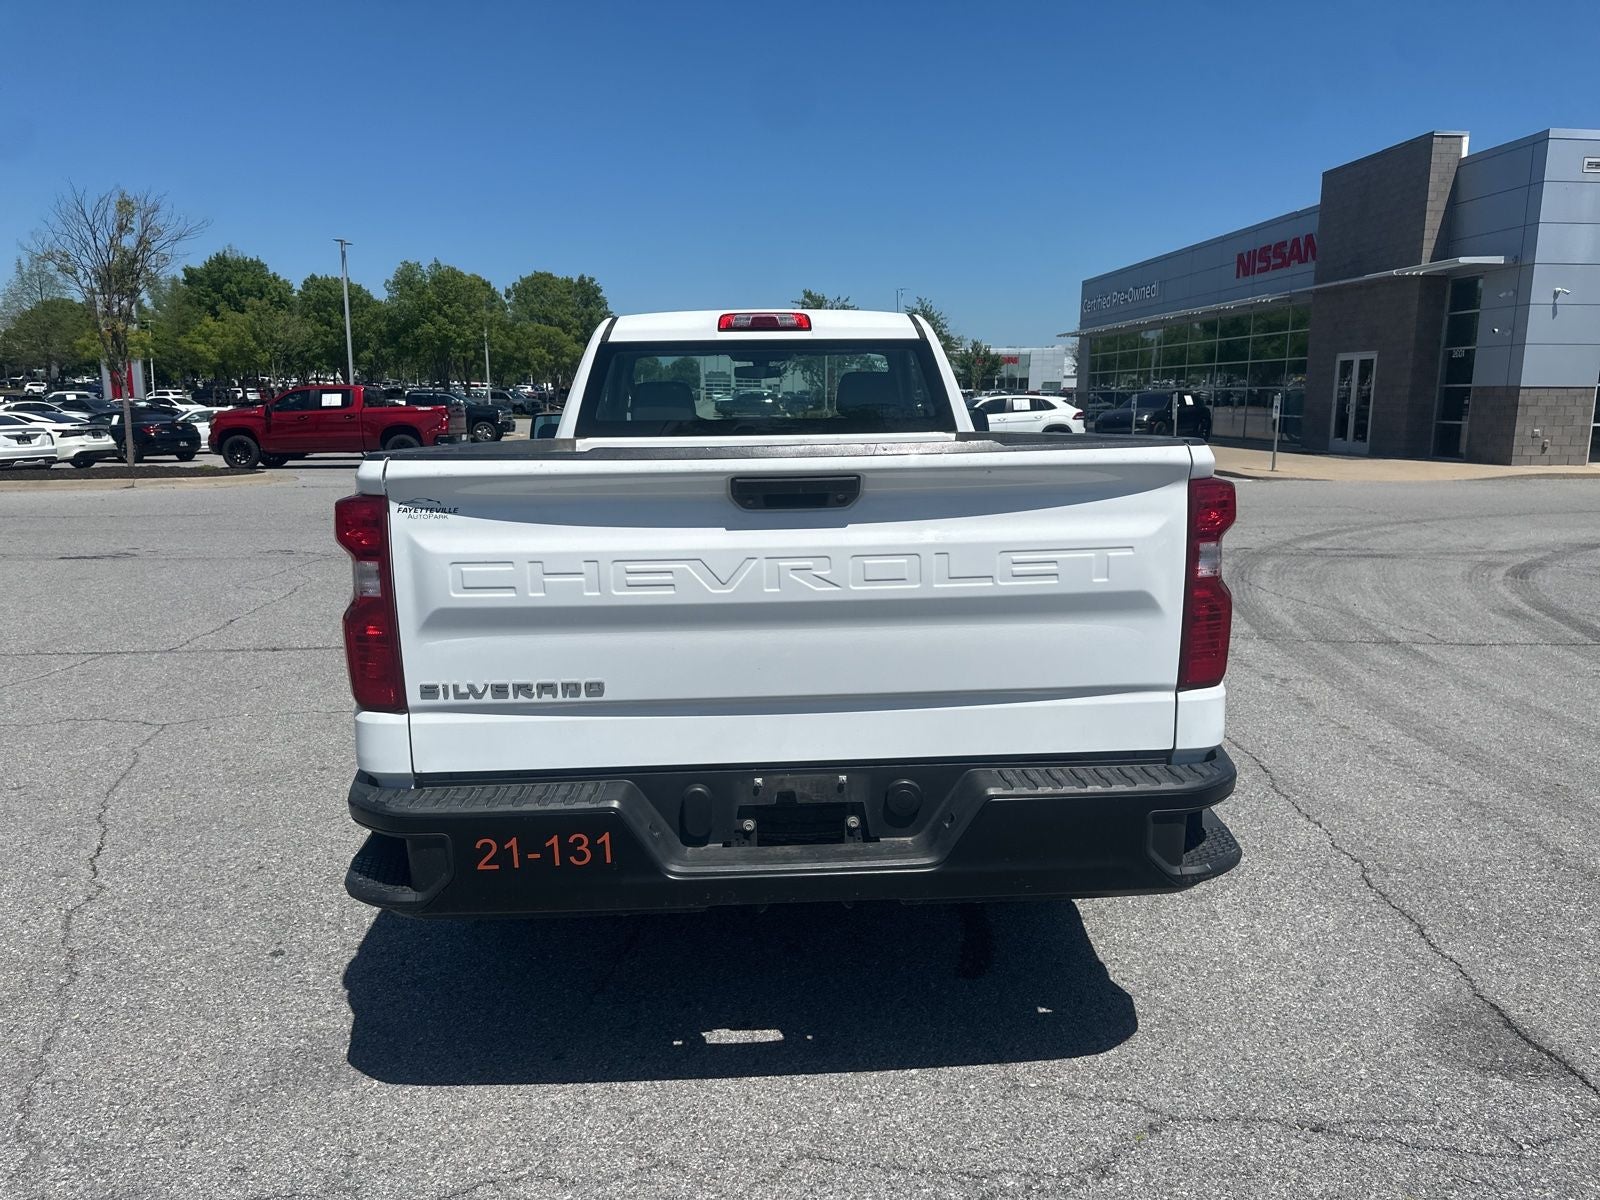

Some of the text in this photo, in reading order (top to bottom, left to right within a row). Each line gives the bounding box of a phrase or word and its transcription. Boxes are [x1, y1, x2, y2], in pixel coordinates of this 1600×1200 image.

[1236, 233, 1317, 279] NISSAN
[1082, 294, 1111, 313] Certified
[449, 546, 1135, 597] CHEVROLET
[419, 681, 605, 700] SILVERADO
[475, 831, 612, 870] 21-131
